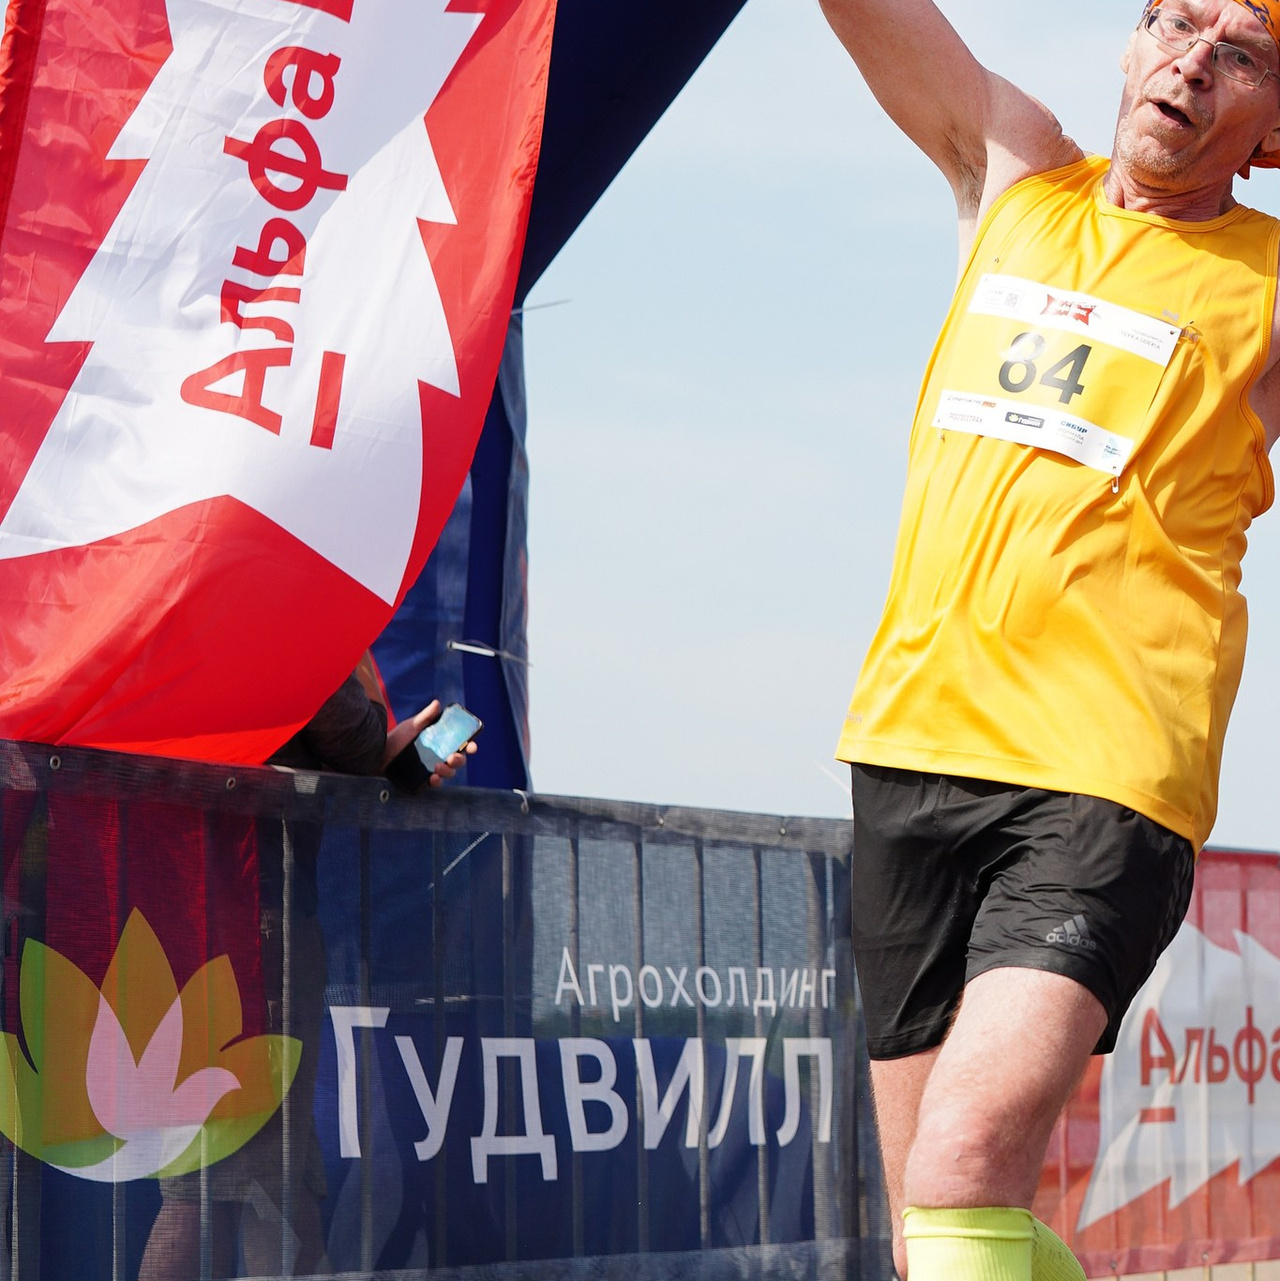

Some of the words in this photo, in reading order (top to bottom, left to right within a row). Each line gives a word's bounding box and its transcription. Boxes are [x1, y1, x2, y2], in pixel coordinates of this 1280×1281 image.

[180, 44, 349, 437] Альфа
[997, 330, 1093, 406] 84
[1045, 931, 1098, 951] adidas
[553, 946, 838, 1022] Агрохолдинг
